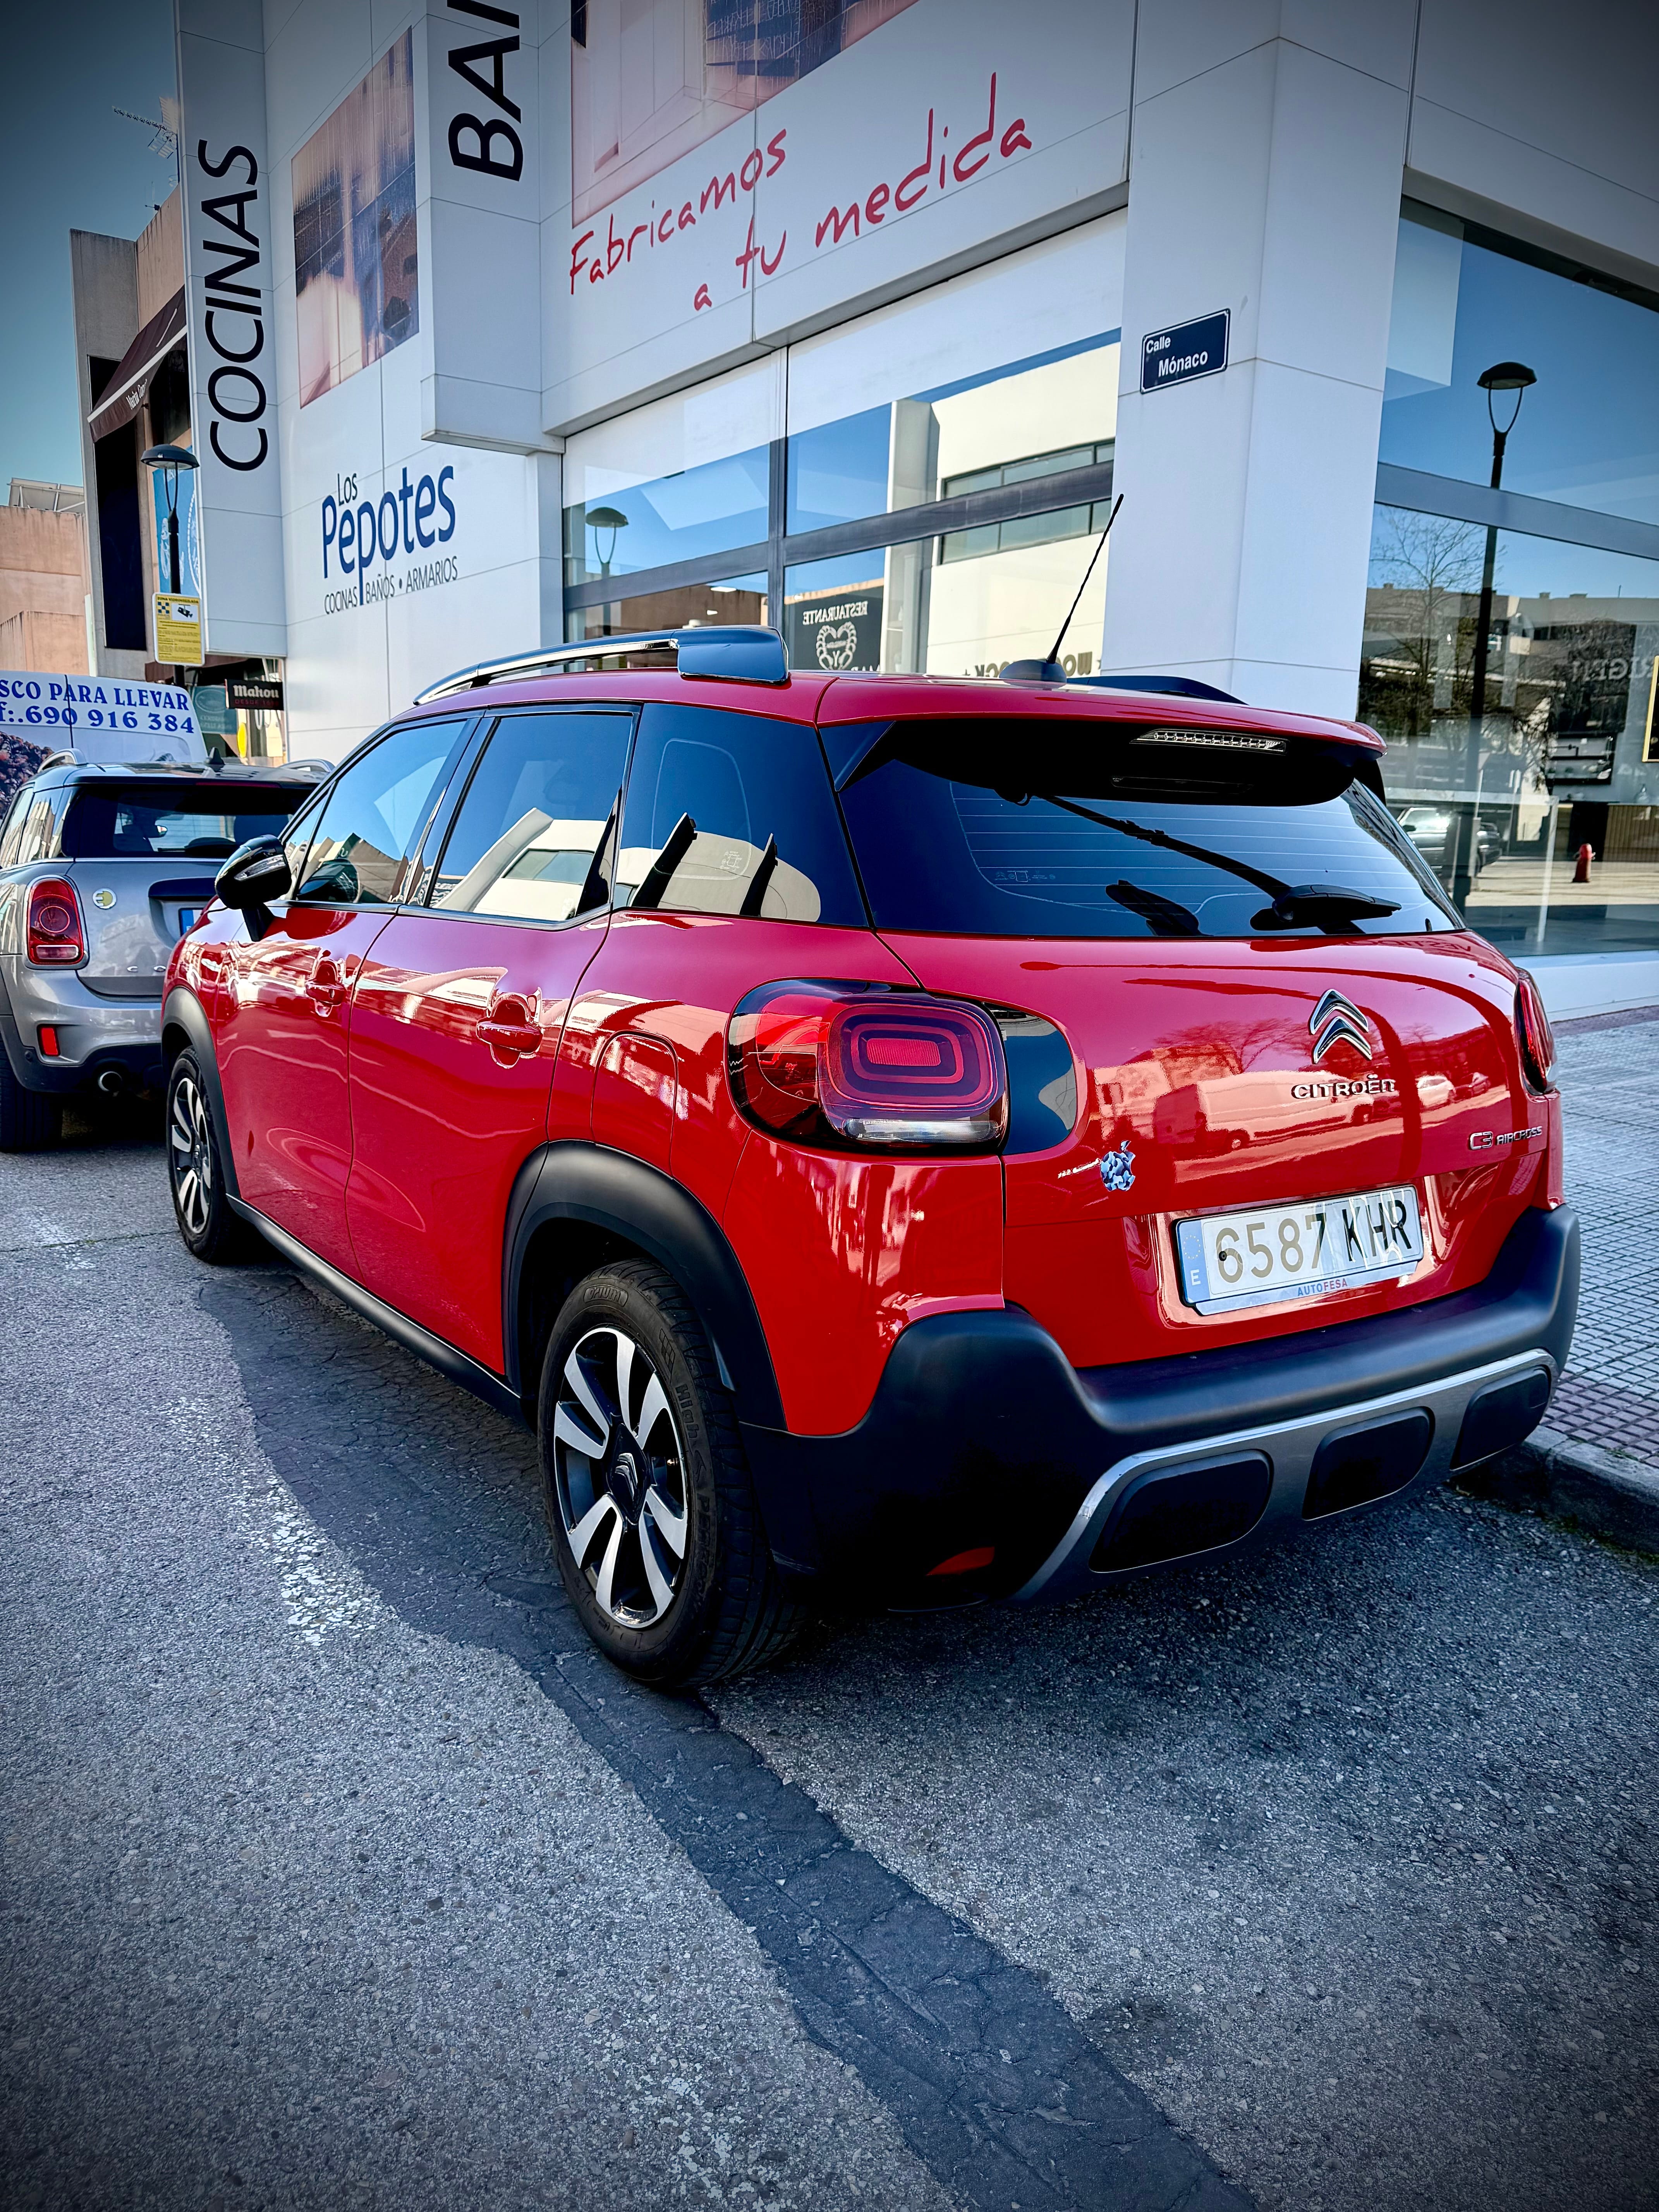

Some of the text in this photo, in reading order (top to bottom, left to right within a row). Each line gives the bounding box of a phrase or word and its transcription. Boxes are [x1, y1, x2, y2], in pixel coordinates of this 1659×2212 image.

[694, 72, 1032, 311] a tu medida
[570, 129, 787, 295] Fabricamos
[198, 139, 269, 471] COCINAS
[1146, 335, 1171, 354] Calle
[1158, 351, 1208, 378] Mónaco
[322, 465, 455, 605] Pepotes
[324, 556, 458, 615] COCINAS BAÑOS ARMARIOS
[49, 683, 107, 704] PARA
[113, 688, 189, 711] LLEVAR
[233, 685, 279, 698] Mahou
[88, 709, 137, 728] 916
[148, 713, 194, 733] 384
[1291, 1074, 1395, 1099] CITROËN
[1468, 1126, 1542, 1150] C3 AIRCROSS
[1216, 1199, 1412, 1283] 6587 KHR
[1191, 1269, 1201, 1286] E
[1297, 1278, 1348, 1297] AUTOFESA
